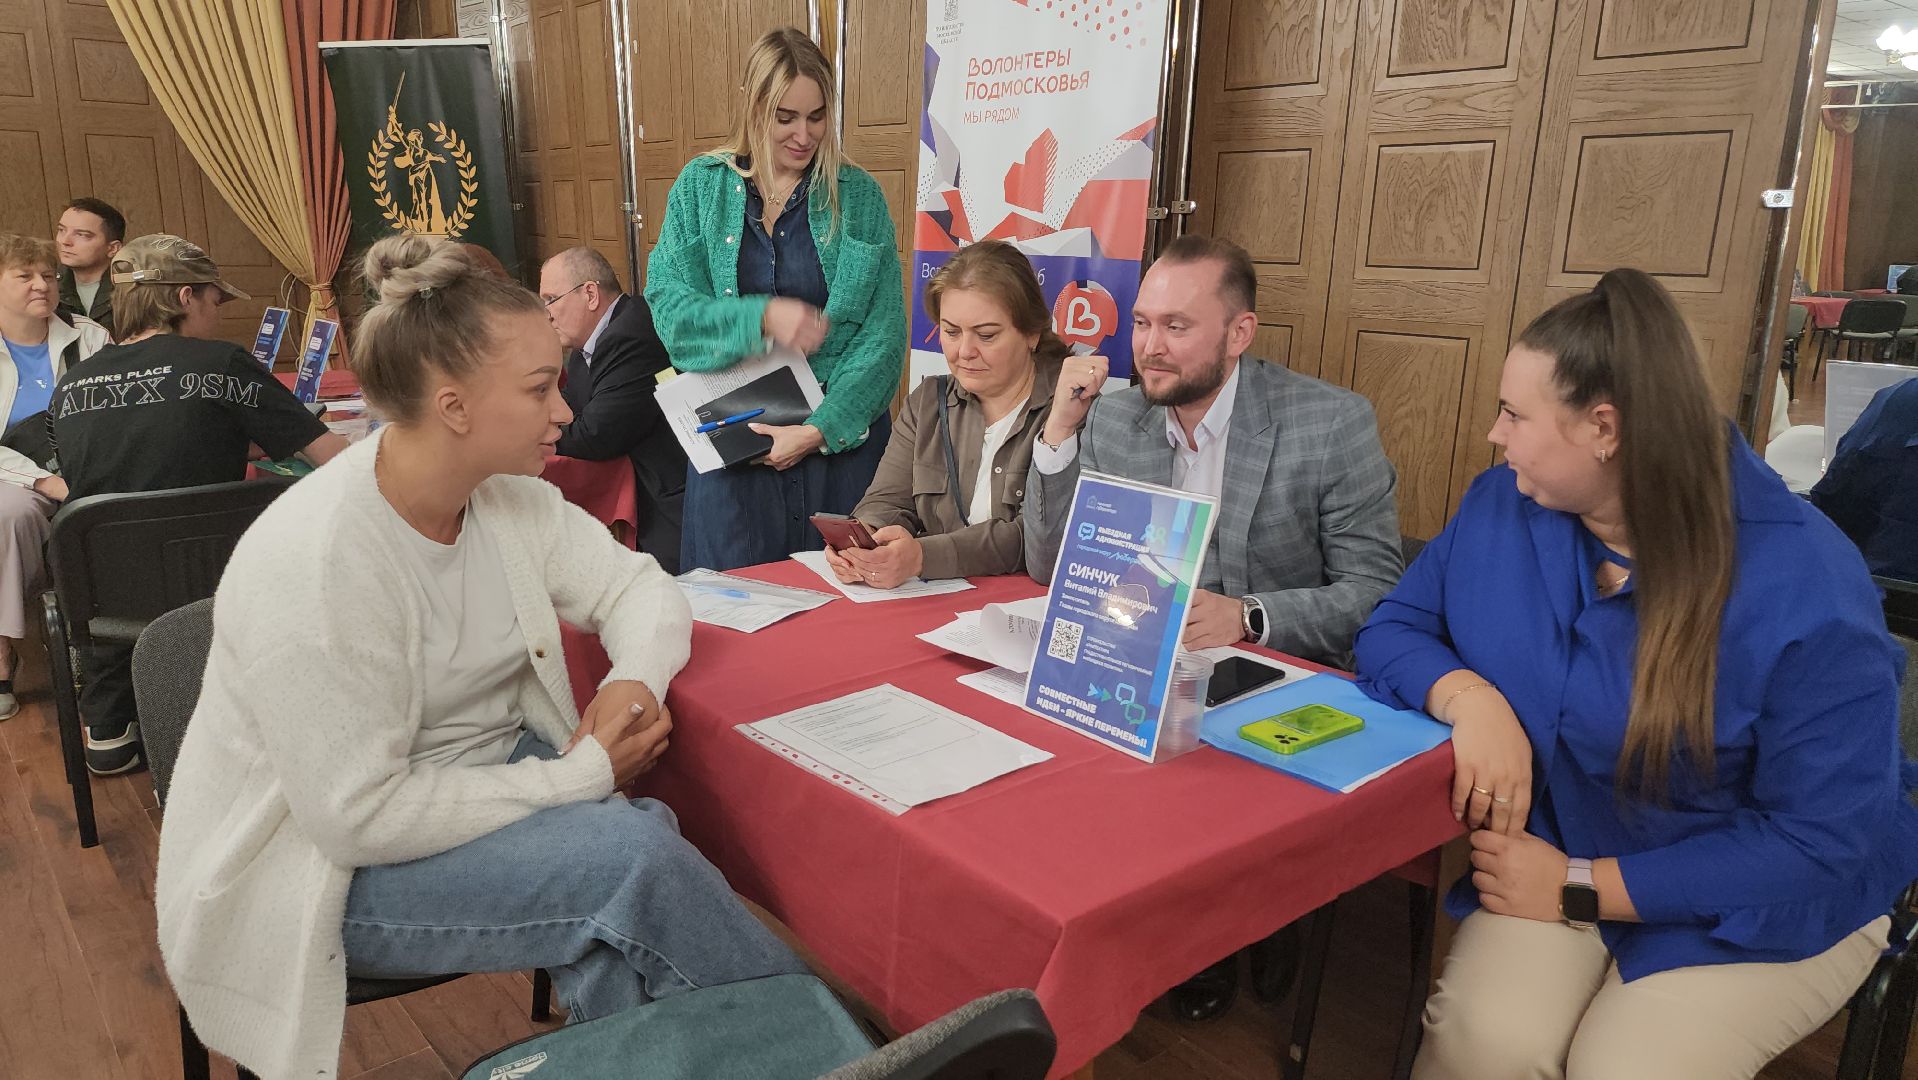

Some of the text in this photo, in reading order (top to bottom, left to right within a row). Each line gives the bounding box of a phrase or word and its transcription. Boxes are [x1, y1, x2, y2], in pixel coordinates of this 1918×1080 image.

[967, 48, 1072, 77] ВОЛОНТЕРЫ
[965, 70, 1090, 101] ПОДМОСКОВЬЯ
[963, 107, 1020, 124] МЫ РЯДОМ
[126, 365, 173, 378] PLACE
[59, 372, 264, 419] ALYX 9SM
[1068, 562, 1121, 587] СИНЧУК
[1063, 578, 1159, 614] Виталий Владимирович
[1036, 696, 1061, 714] ИДЕИ
[1065, 708, 1095, 728] ЯРКИЕ
[1038, 684, 1098, 714] СОВМЕСТНЫЕ
